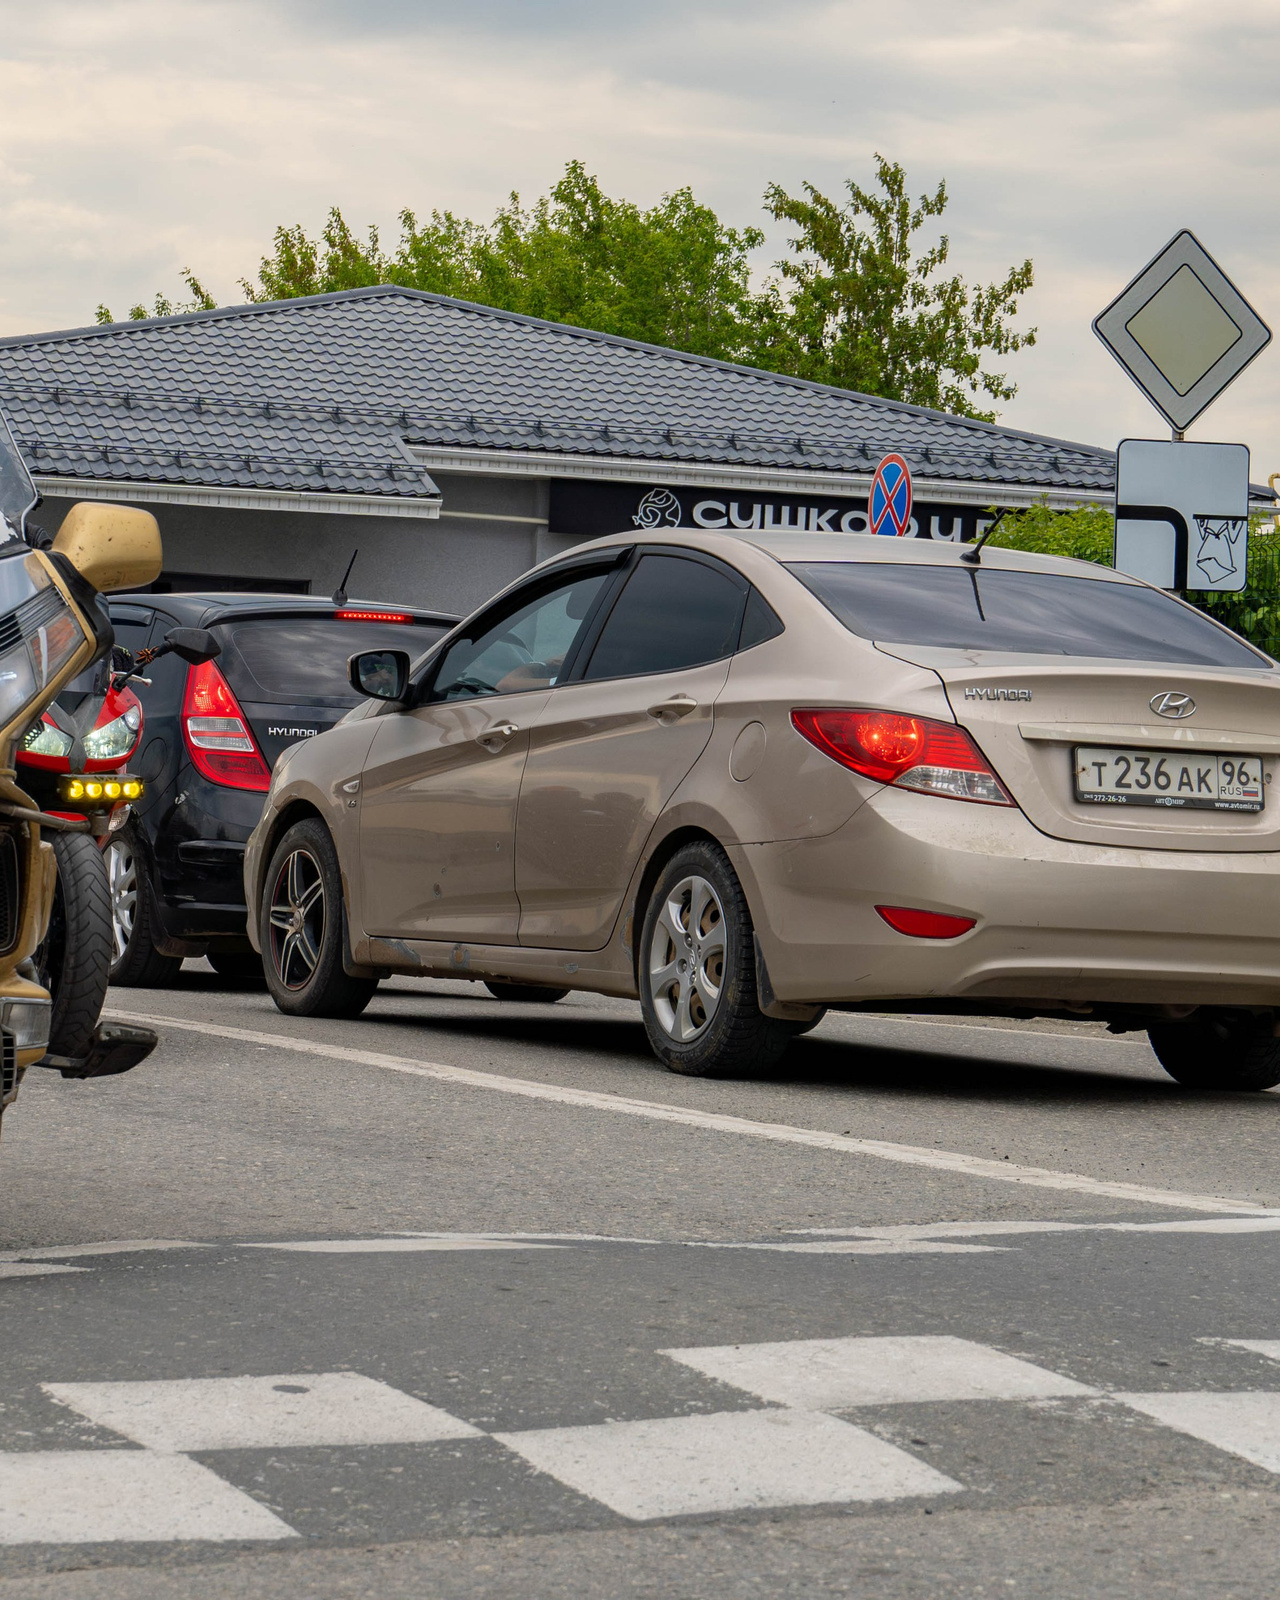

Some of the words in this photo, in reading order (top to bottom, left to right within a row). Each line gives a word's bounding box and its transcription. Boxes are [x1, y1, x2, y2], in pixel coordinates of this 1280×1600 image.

[965, 688, 1032, 702] HYUNDAI
[268, 727, 318, 738] HYUNDAI
[1221, 761, 1251, 786] 96
[1220, 786, 1242, 796] RUS
[1093, 794, 1127, 803] 272-26-26
[1214, 801, 1261, 811] www.avtomir.ru
